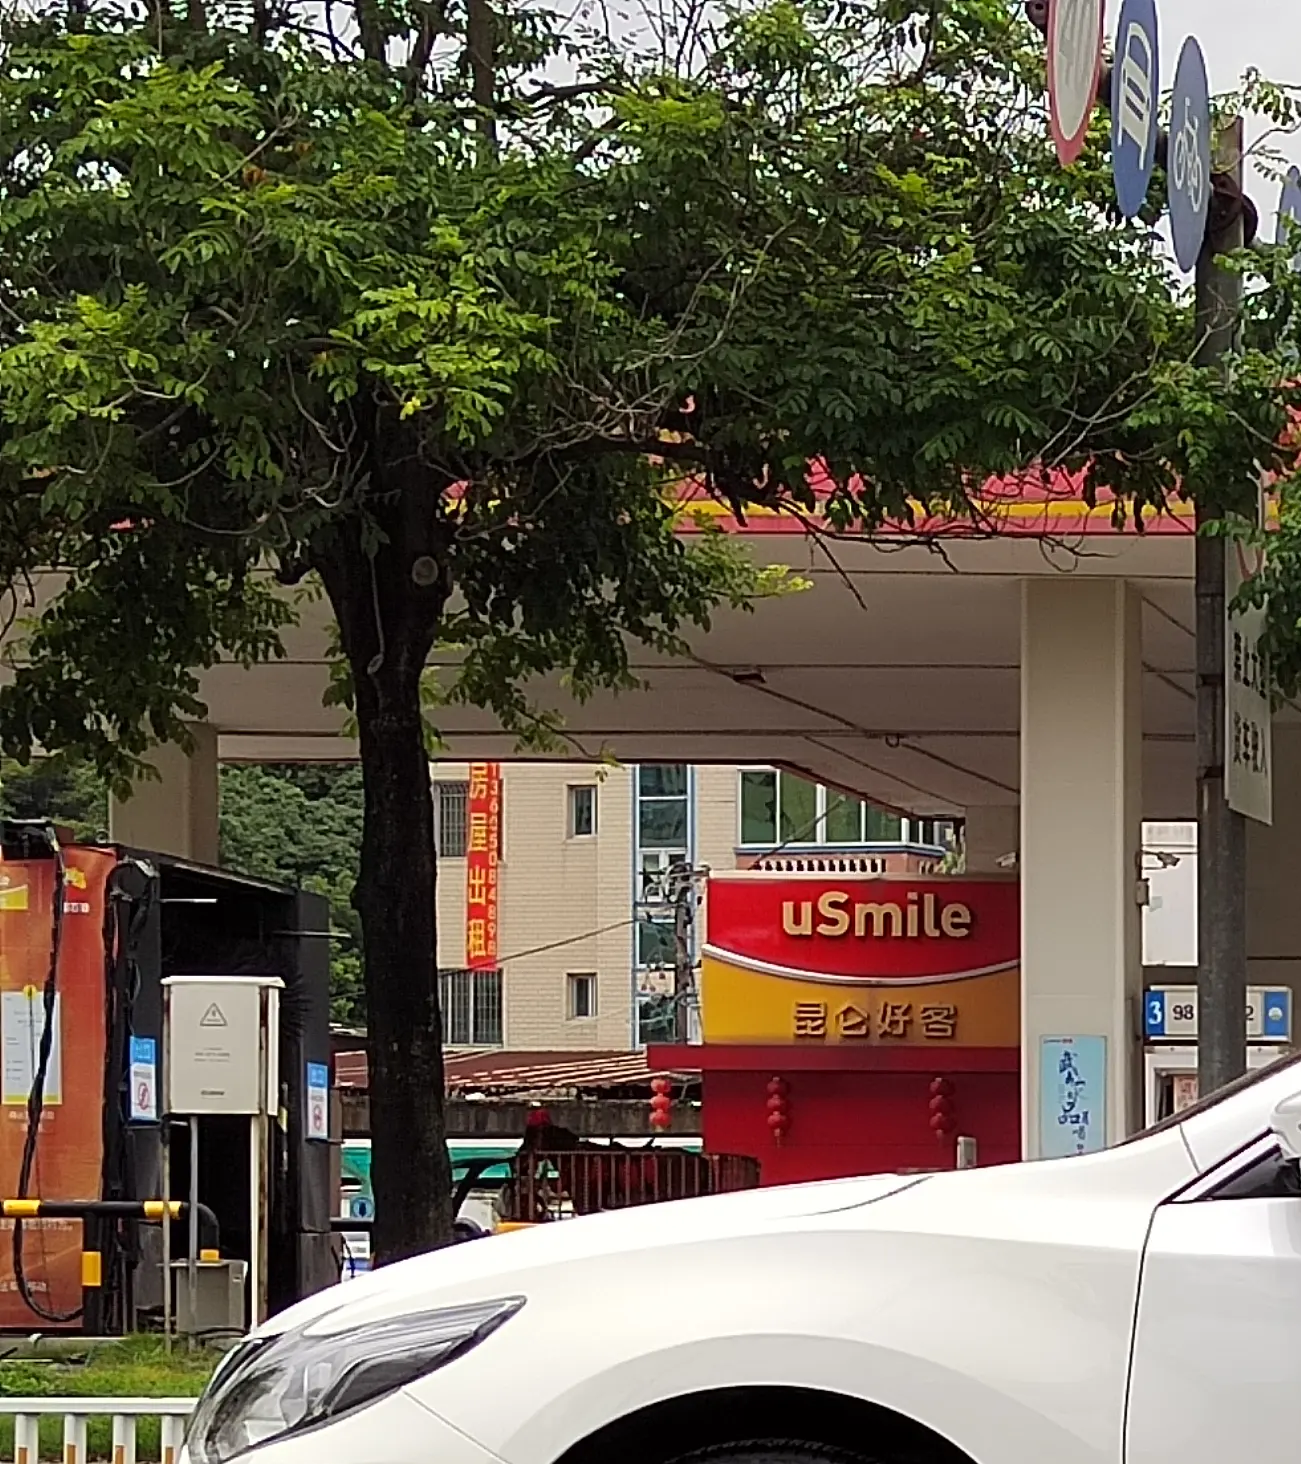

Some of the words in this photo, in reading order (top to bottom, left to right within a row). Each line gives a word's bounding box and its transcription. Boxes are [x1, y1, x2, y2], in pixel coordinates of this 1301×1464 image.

[782, 891, 971, 938] uSmile
[794, 1000, 957, 1038] 昆仑好客
[1148, 1001, 1163, 1025] 3
[1173, 1004, 1194, 1021] 98
